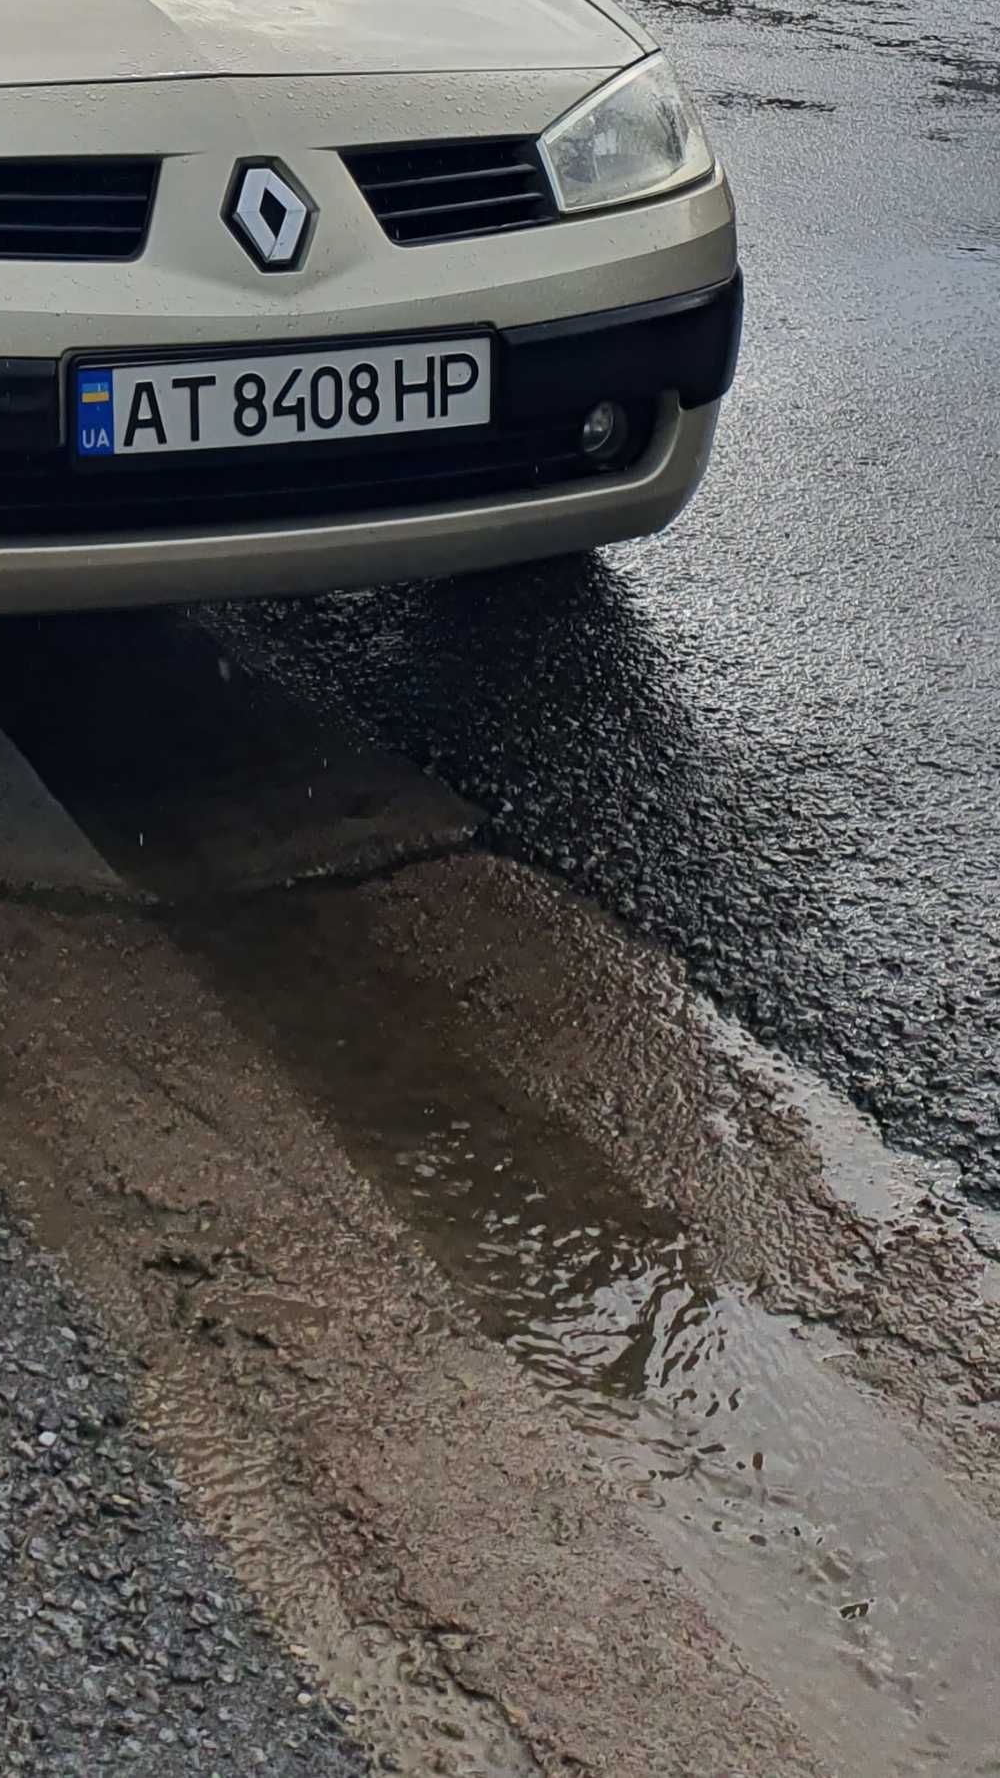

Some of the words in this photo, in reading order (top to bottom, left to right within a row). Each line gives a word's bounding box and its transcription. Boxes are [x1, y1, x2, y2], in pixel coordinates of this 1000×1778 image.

[123, 375, 217, 447] AT
[233, 362, 381, 437] 8408
[394, 352, 480, 422] HP
[81, 427, 111, 449] UA
